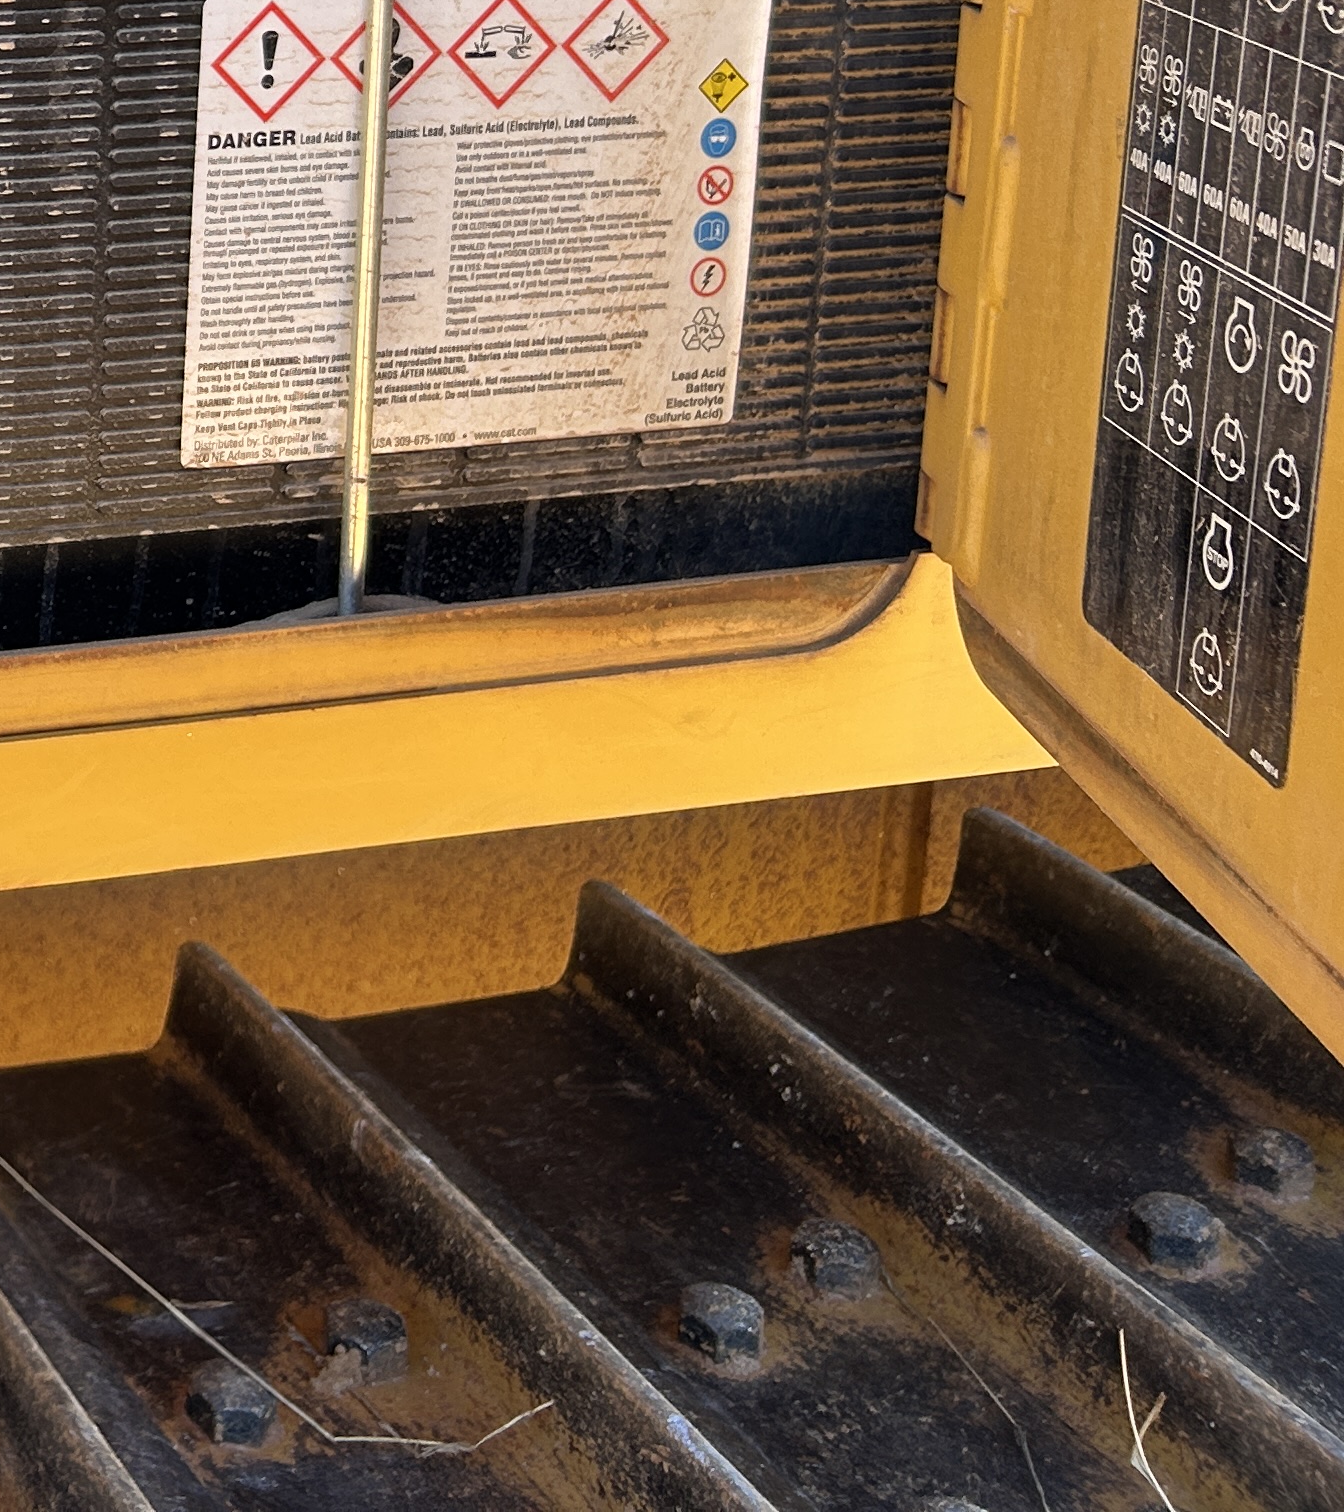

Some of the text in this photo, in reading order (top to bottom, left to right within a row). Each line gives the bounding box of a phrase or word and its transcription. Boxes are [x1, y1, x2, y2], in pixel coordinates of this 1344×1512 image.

[206, 130, 297, 150] DANGER
[386, 127, 420, 138] ontains:
[1130, 148, 1148, 173] 40A
[1153, 159, 1172, 185] 40A
[1178, 171, 1197, 198] 60A
[1203, 184, 1223, 211] 60A
[1230, 197, 1250, 226] 60A
[1255, 211, 1278, 240] 40A
[1283, 224, 1306, 255] 50A
[1312, 239, 1336, 270] 30A
[1206, 545, 1229, 570] STOP
